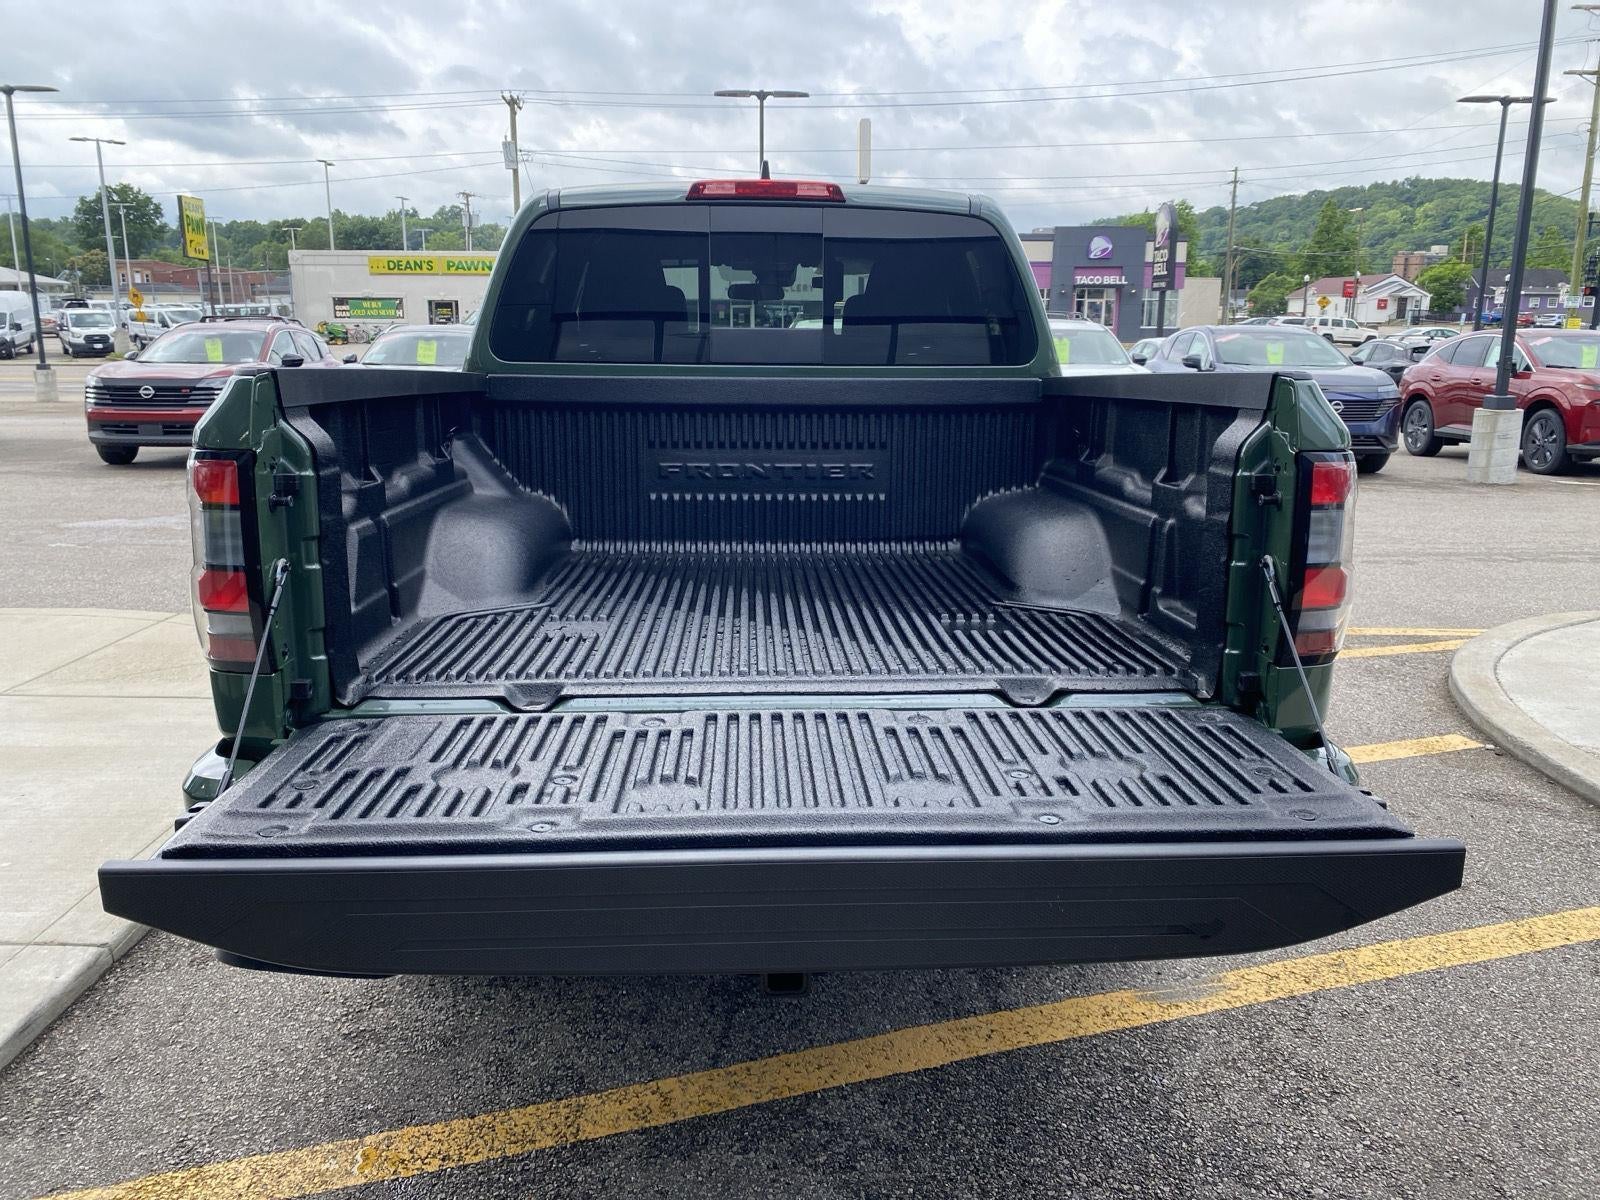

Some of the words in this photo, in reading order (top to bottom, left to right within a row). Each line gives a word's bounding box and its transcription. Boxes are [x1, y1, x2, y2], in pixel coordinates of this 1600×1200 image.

[1153, 249, 1169, 263] TACO
[446, 259, 493, 272] PAWN
[1153, 262, 1168, 276] BELL
[1074, 275, 1102, 284] TACO
[1103, 275, 1128, 284] BELL
[659, 462, 875, 479] FRONTIER
